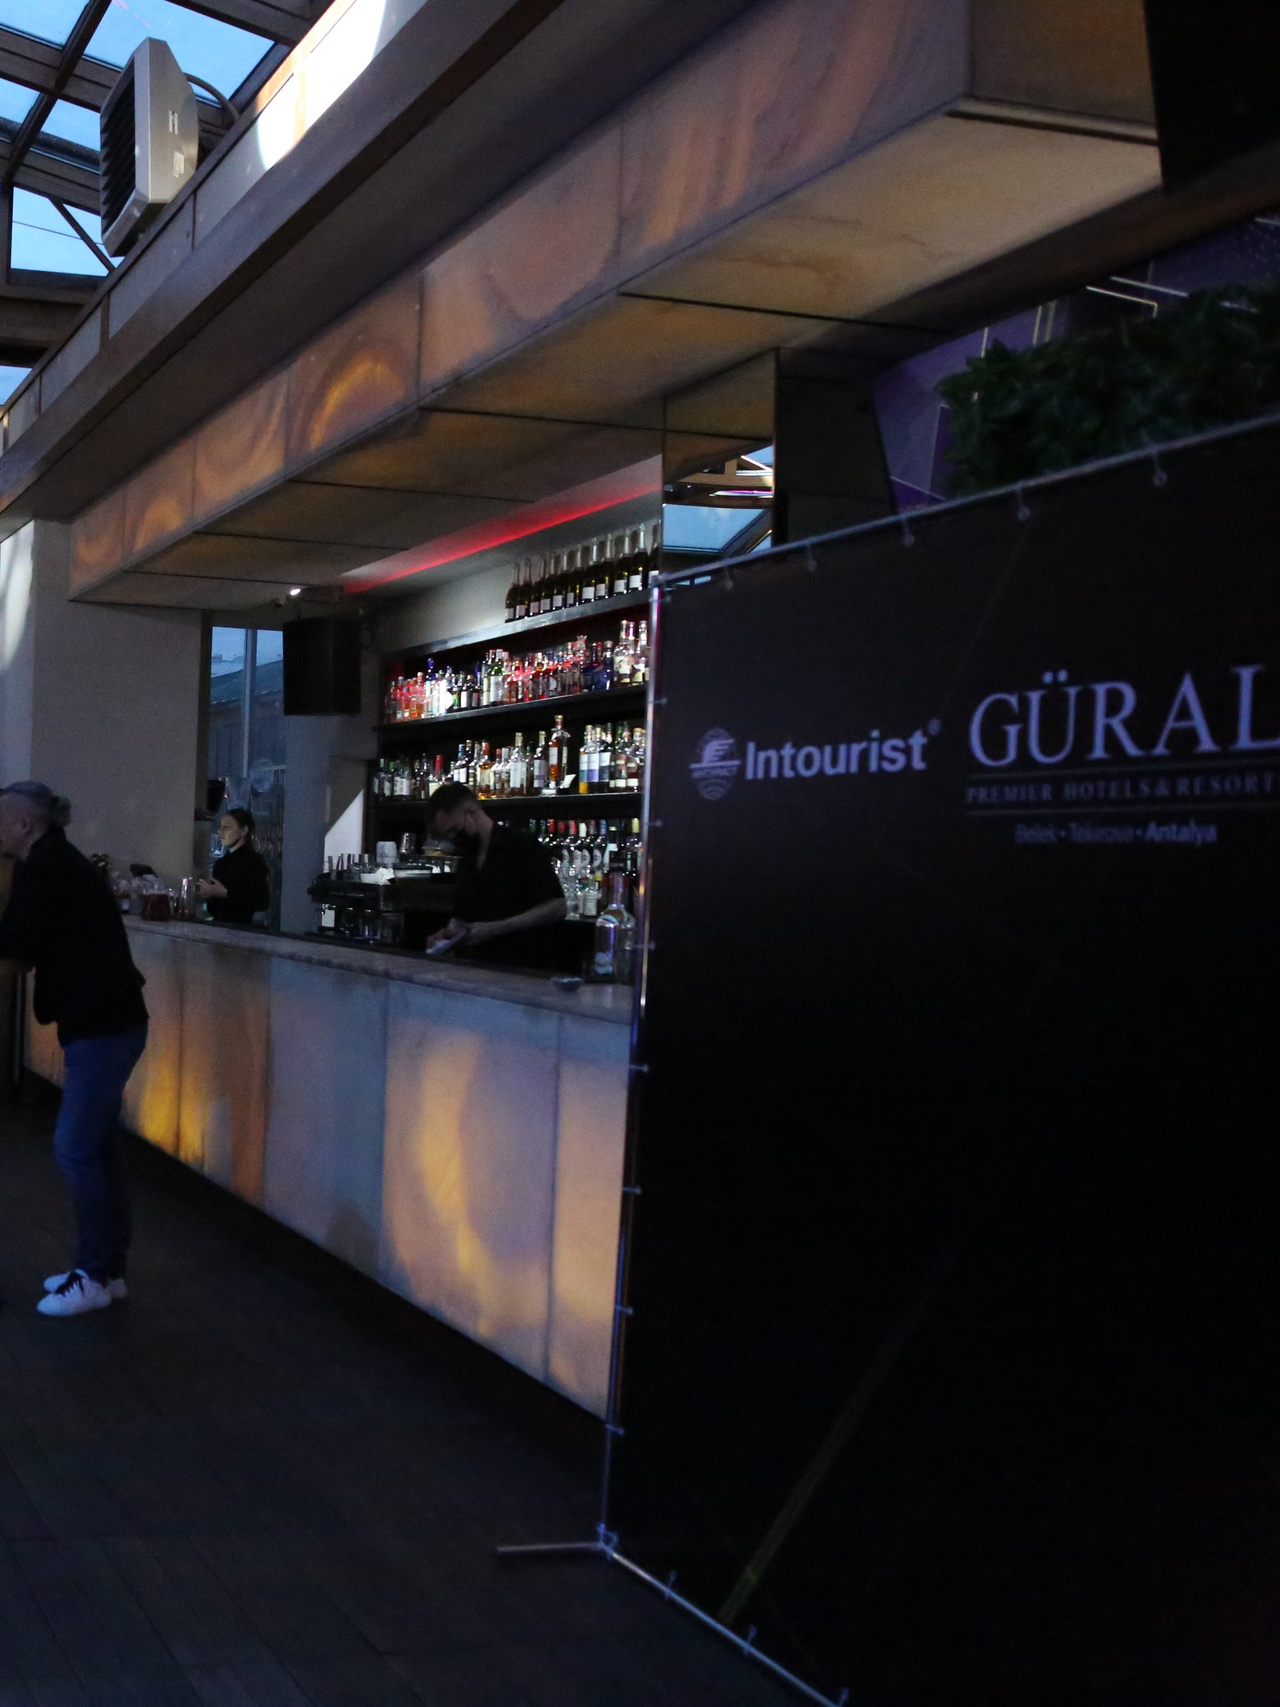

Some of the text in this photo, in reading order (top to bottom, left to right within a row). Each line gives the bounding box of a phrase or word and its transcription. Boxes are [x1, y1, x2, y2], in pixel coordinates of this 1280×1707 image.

[970, 664, 1280, 767] GÜRAL
[745, 729, 929, 780] Intourist
[966, 783, 1053, 804] PREMIER
[1145, 819, 1218, 849] Antalya
